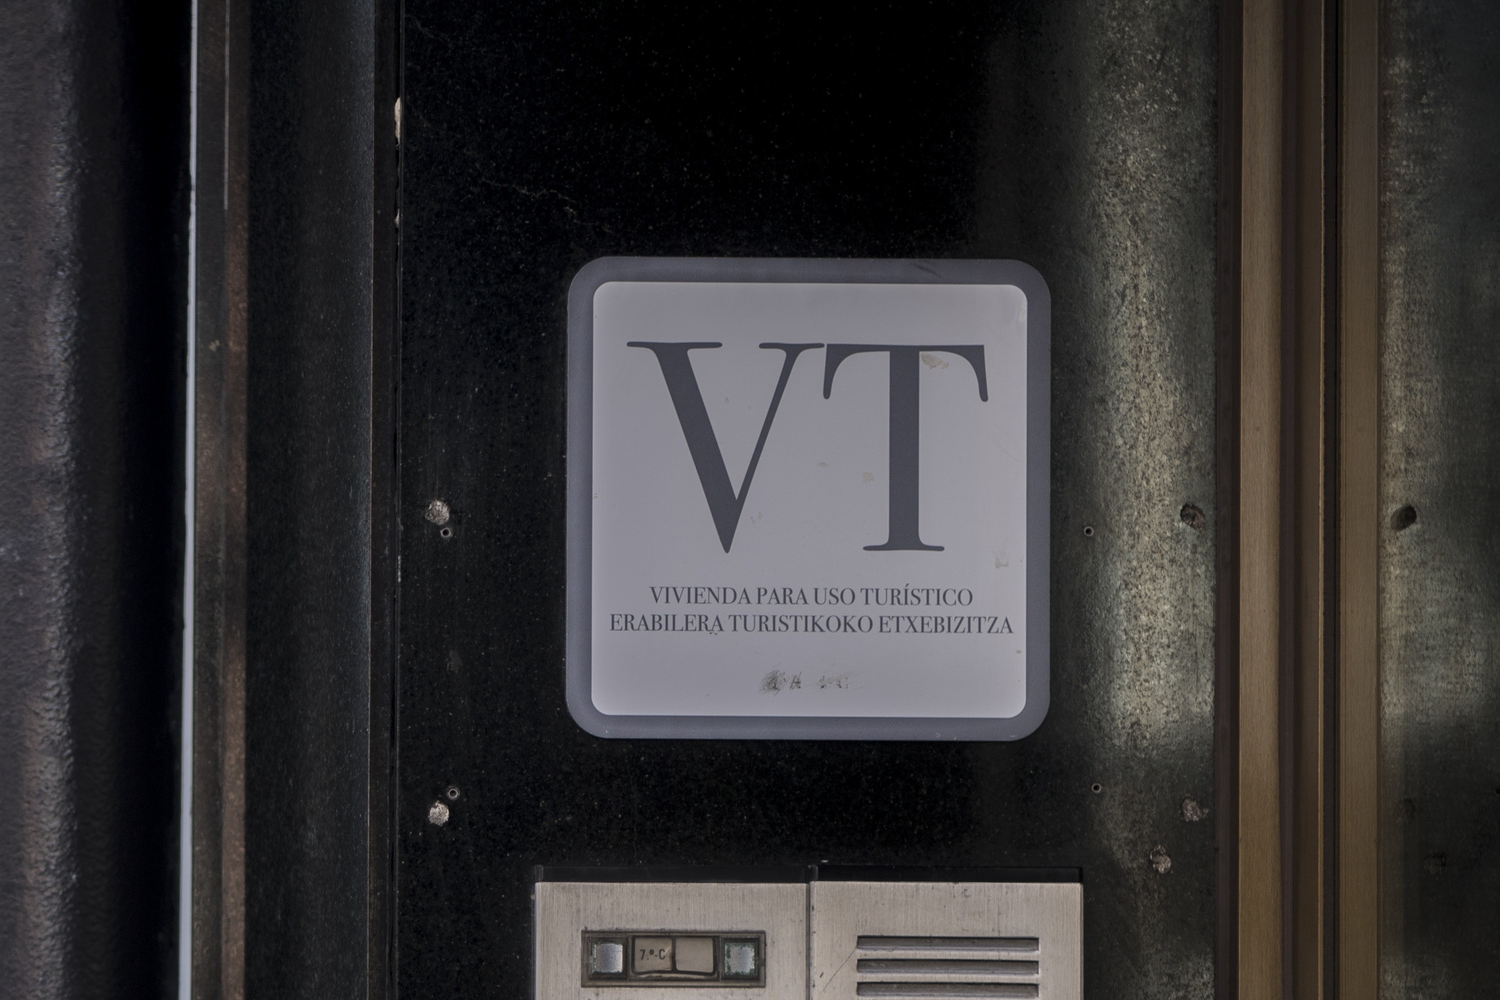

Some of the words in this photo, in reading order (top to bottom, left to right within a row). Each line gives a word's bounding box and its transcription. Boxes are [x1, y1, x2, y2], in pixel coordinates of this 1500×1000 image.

[626, 341, 989, 554] VT
[650, 586, 751, 605] VIVIENDA
[757, 587, 809, 605] PARA
[814, 588, 856, 605] USO
[860, 584, 973, 606] TURÍSTICO
[610, 614, 724, 632] ERABILERA
[728, 614, 874, 633] TURISTIKOKO
[879, 615, 1014, 634] ETXEBIZITZA
